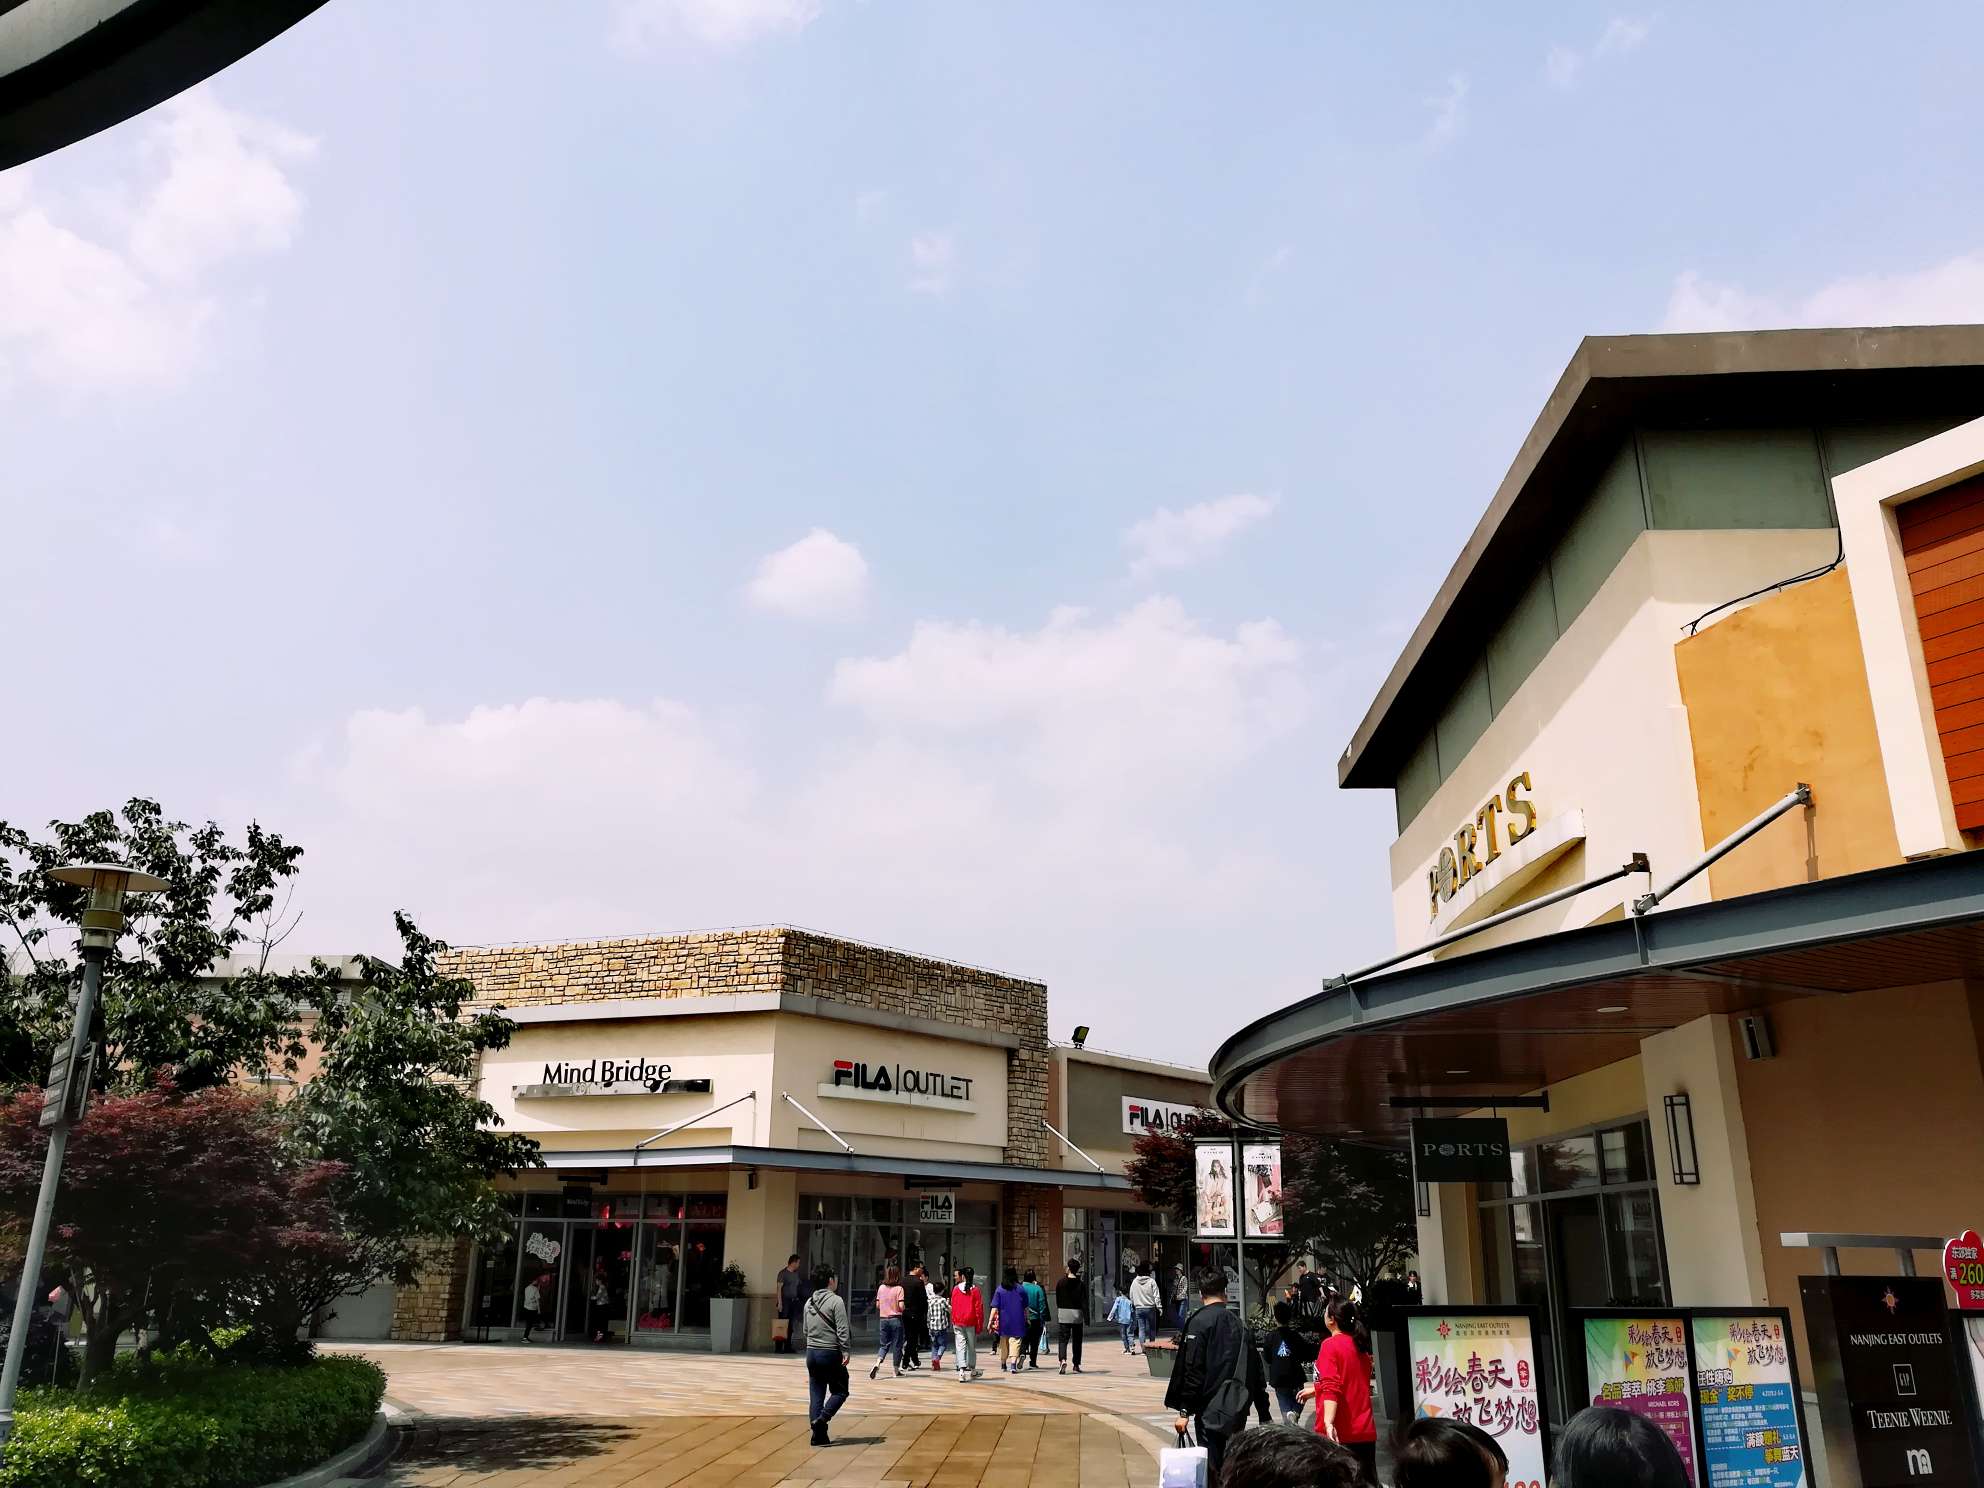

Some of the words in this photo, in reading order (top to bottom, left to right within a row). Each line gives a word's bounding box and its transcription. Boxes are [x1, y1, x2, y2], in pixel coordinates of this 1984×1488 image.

[1427, 772, 1537, 924] PORTS
[543, 1060, 597, 1084] Mind
[601, 1058, 672, 1089] Bridge
[834, 1060, 892, 1091] FILA
[903, 1069, 973, 1101] OUTLET
[1128, 1104, 1165, 1129] FILA
[1423, 1143, 1504, 1157] PORTS
[921, 1195, 952, 1209] FILA
[921, 1210, 952, 1220] OUTLET
[1627, 1322, 1674, 1347] 彩绘春天
[1729, 1320, 1772, 1344] 彩绘春天
[1850, 1333, 1887, 1348] NANJING
[1889, 1333, 1907, 1345] EAST
[1908, 1332, 1943, 1345] OUTLETS
[1645, 1347, 1688, 1371] 放飞梦想
[1747, 1343, 1787, 1367] 放飞梦想
[1415, 1351, 1514, 1398] 彩绘春天
[1452, 1396, 1541, 1438] 放飞梦想
[1866, 1409, 1910, 1429] TEENIE
[1910, 1407, 1953, 1427] WEENIE
